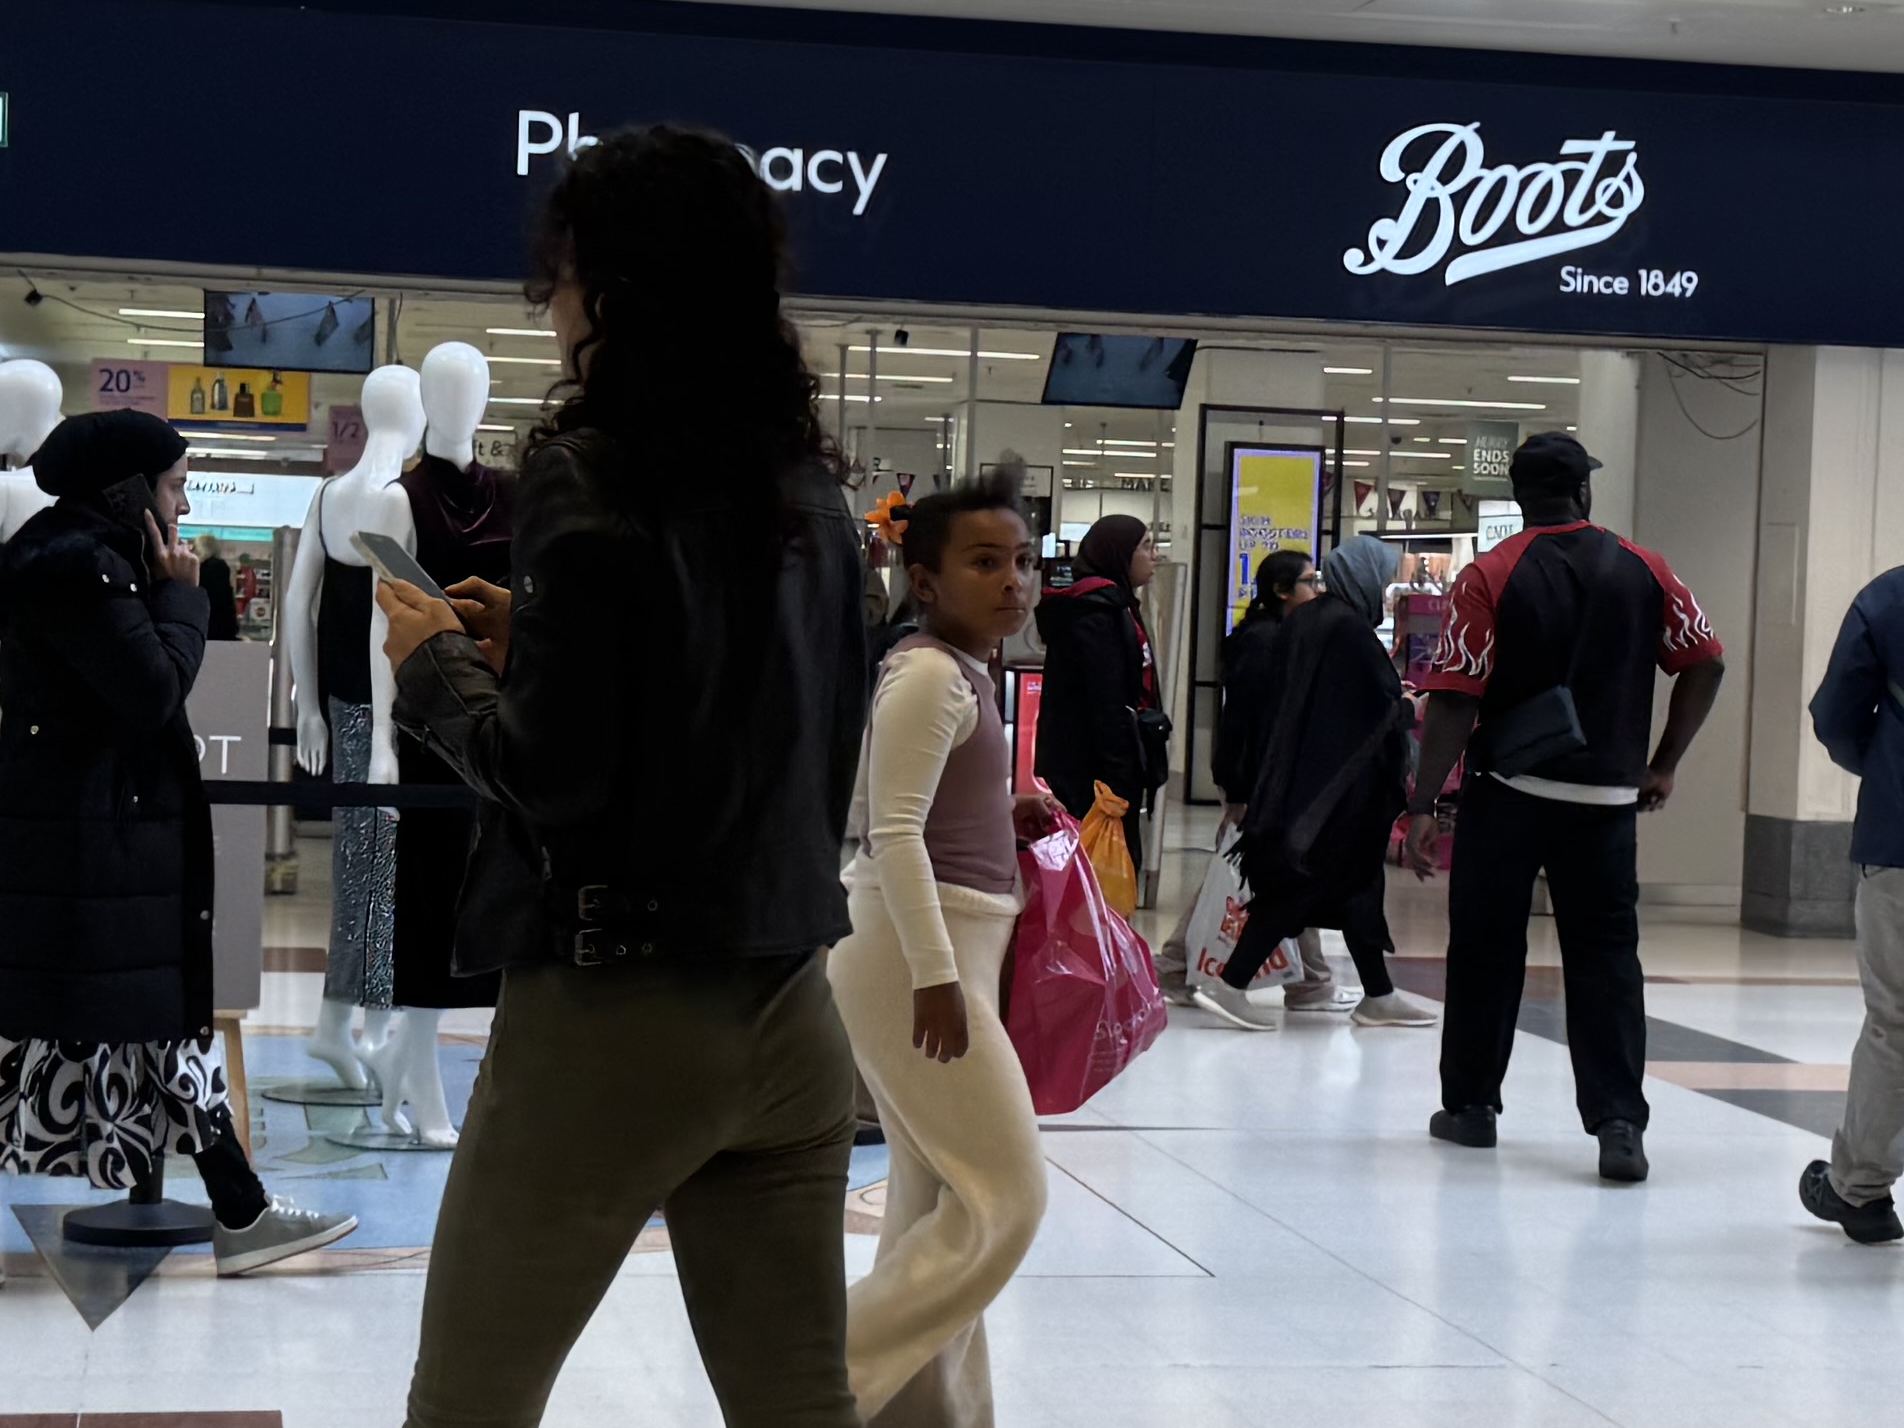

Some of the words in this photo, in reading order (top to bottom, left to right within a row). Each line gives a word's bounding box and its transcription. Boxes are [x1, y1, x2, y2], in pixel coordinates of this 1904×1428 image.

[517, 109, 889, 216] Phacy
[1342, 121, 1645, 286] Boots
[1559, 265, 1630, 296] Since
[1638, 268, 1699, 298] 1849
[1473, 448, 1510, 463] ENDS
